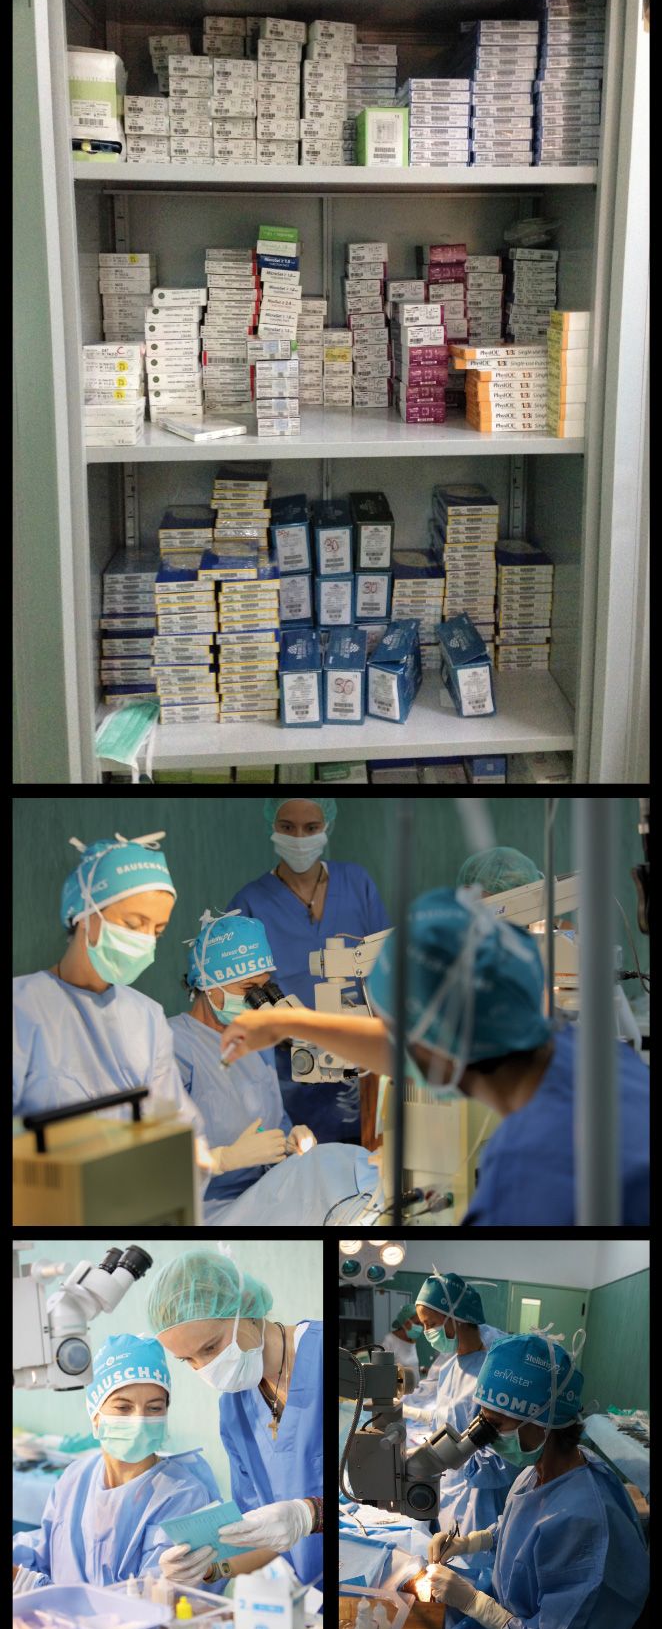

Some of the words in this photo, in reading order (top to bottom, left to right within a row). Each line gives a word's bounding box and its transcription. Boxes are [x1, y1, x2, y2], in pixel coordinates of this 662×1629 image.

[116, 346, 125, 355] C
[334, 677, 355, 695] 30
[493, 1368, 532, 1387] enVista
